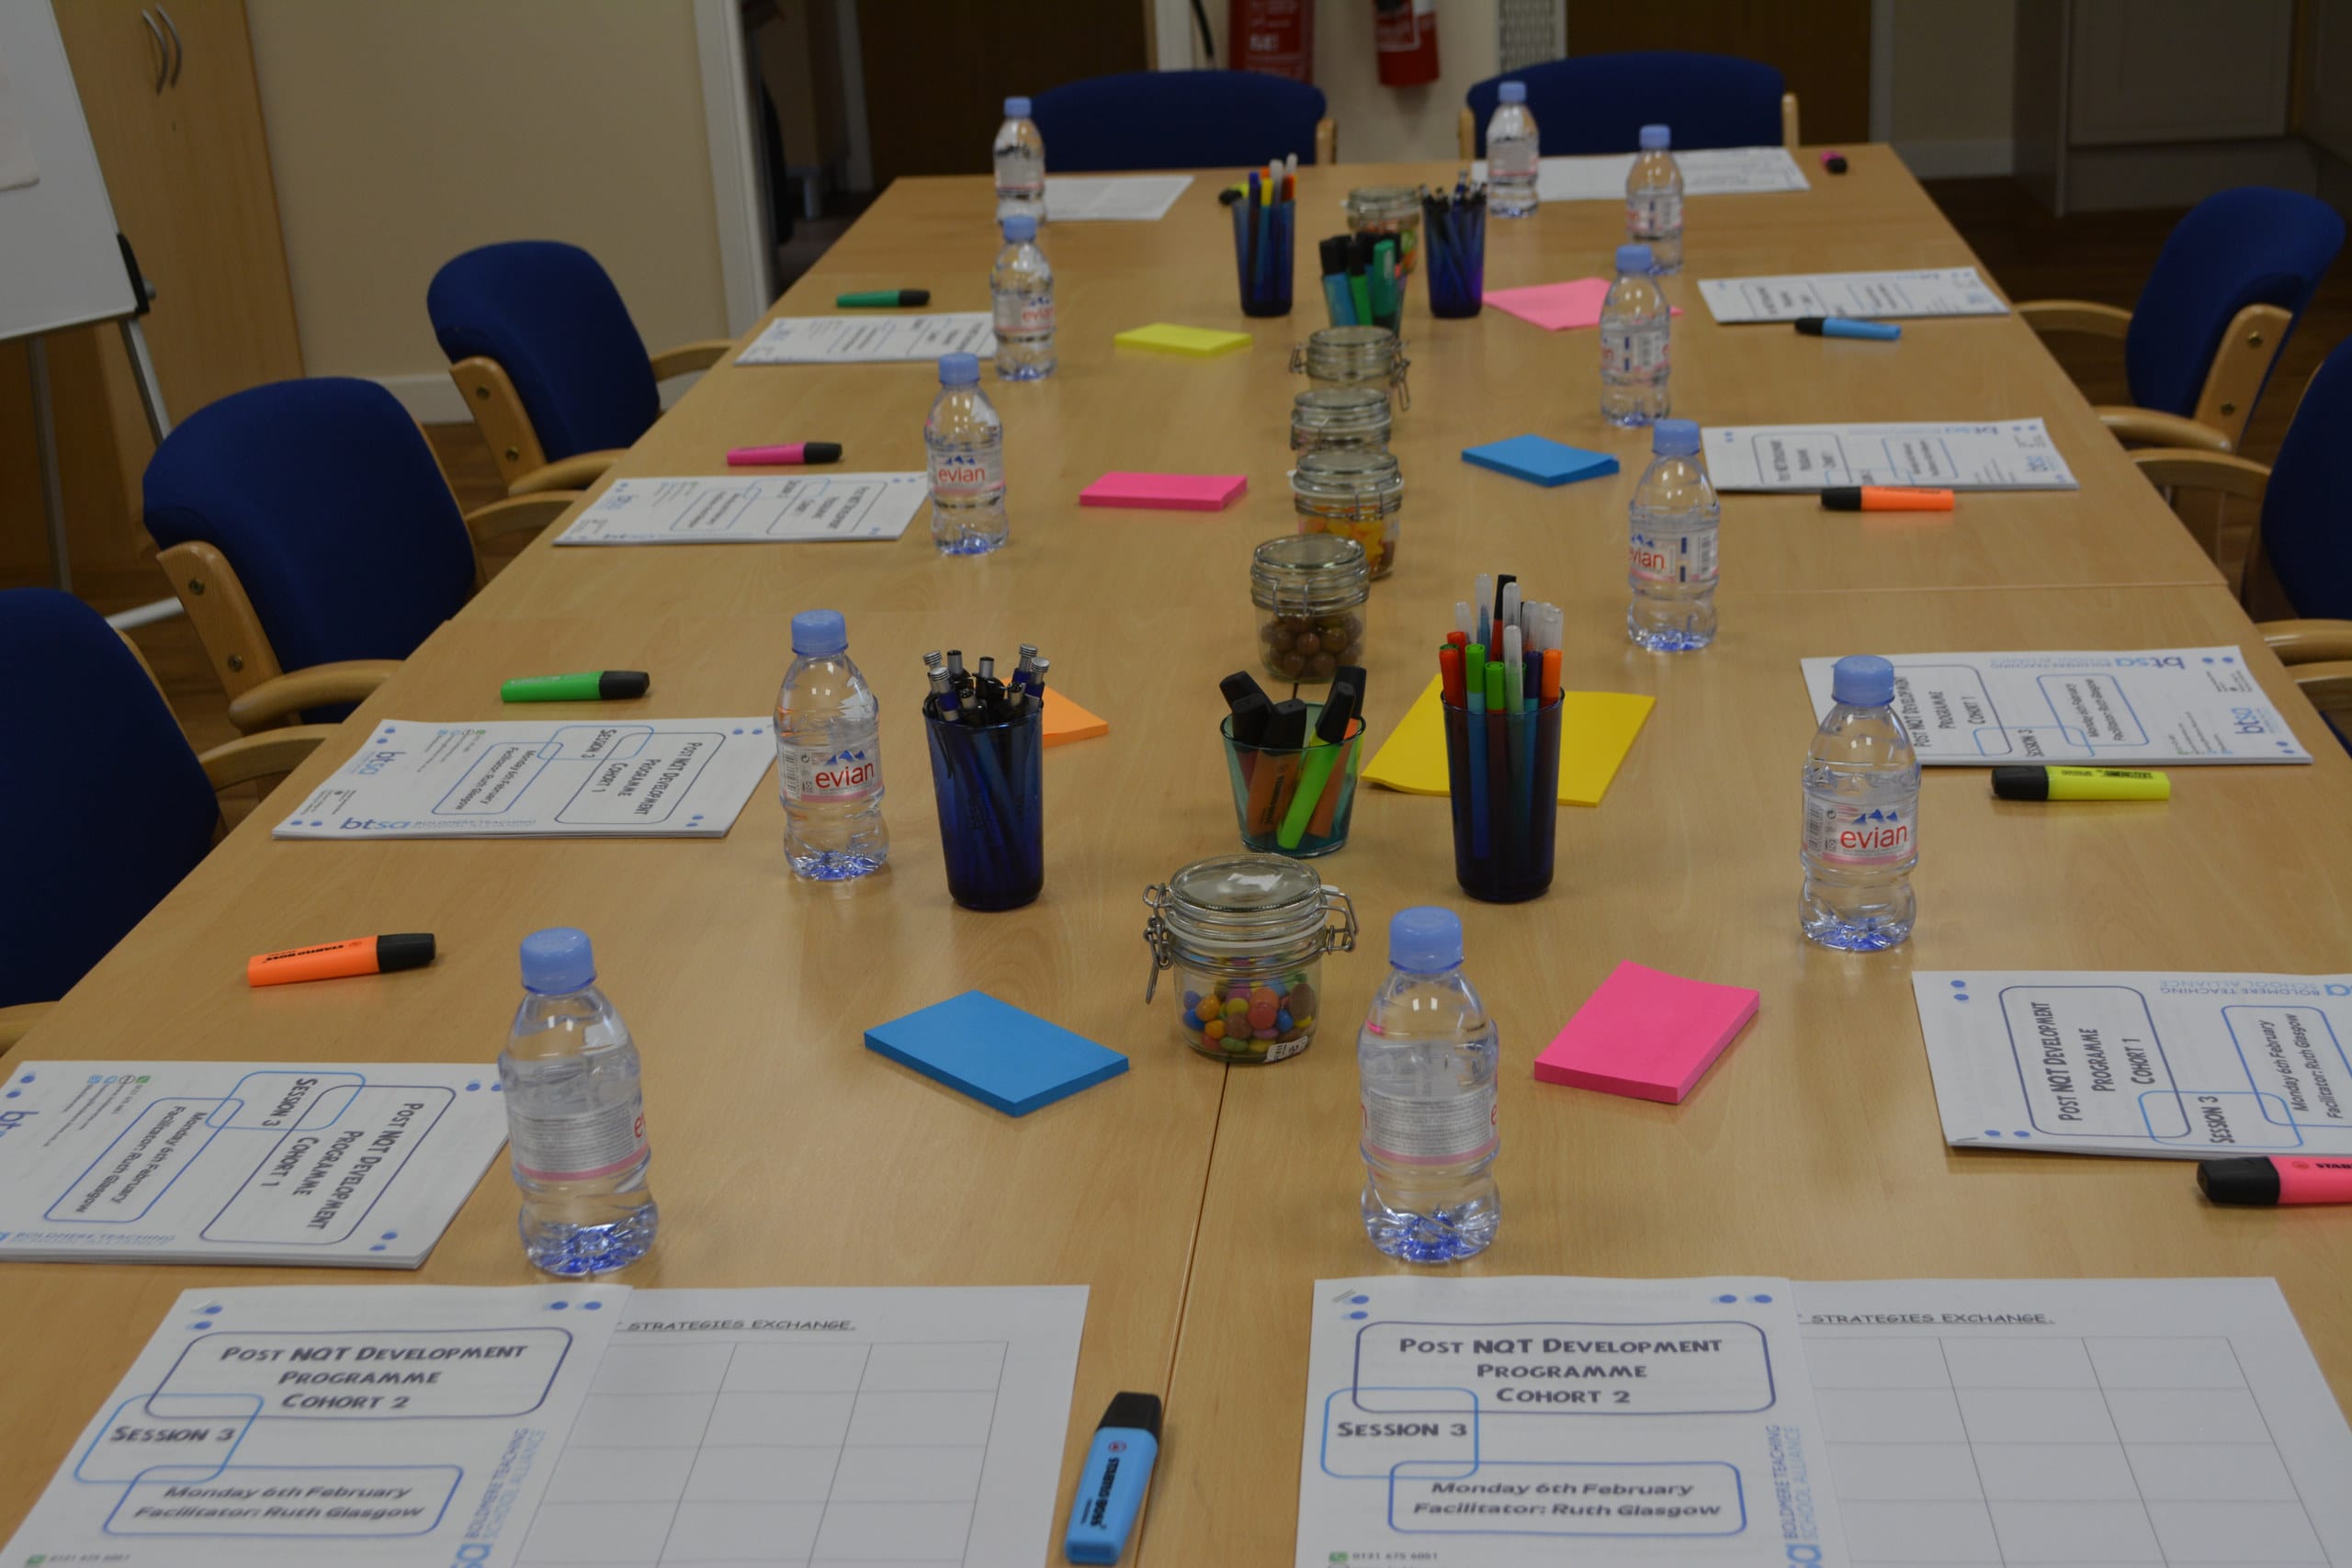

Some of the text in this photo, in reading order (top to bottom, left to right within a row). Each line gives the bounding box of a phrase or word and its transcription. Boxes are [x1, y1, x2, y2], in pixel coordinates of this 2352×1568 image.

[938, 467, 986, 483] evian
[1629, 547, 1665, 570] vian
[815, 761, 874, 788] evian
[343, 817, 412, 829] btsa
[1840, 825, 1907, 849] evian
[2286, 1013, 2311, 1049] Glasgow
[2030, 1001, 2083, 1121] POST NQT DEVELOPMENT
[2078, 1028, 2116, 1091] PROGRAMME
[2124, 1046, 2155, 1085] COHORT
[2258, 1020, 2309, 1111] Monday 6th February
[2300, 1048, 2322, 1069] Ruth
[262, 1077, 319, 1128] SESSION 3
[165, 1111, 208, 1146] Monday
[2198, 1095, 2235, 1144] SESSION 3
[112, 1152, 142, 1175] Ruth
[270, 1136, 319, 1178] COHORT
[291, 1131, 364, 1196] PROGRAMME
[306, 1102, 425, 1230] POST NQT DEVELOPMENT
[75, 1174, 119, 1213] Glasgow
[110, 1163, 160, 1203] February
[628, 1320, 744, 1330] STRATEGIES
[1811, 1314, 1934, 1324] STRATEGIES
[220, 1345, 529, 1362] POST NQT DEVELOPMENT
[1399, 1337, 1723, 1354] POST NQT DEVELOPMENT
[277, 1371, 443, 1384] PROGRAMME
[1476, 1364, 1647, 1378] PROGRAMME
[281, 1393, 411, 1409] COHORT 2
[1496, 1388, 1630, 1404] COHORT 2
[110, 1426, 236, 1442] SESSION 3
[1337, 1422, 1467, 1437] SESSION 3
[164, 1486, 413, 1500] Monday 6th February
[1431, 1483, 1694, 1496] Monday 6th February
[135, 1506, 425, 1520] Facilitator: Ruth Glasgow
[1413, 1503, 1721, 1518] Facilitator: Ruth Glasgow
